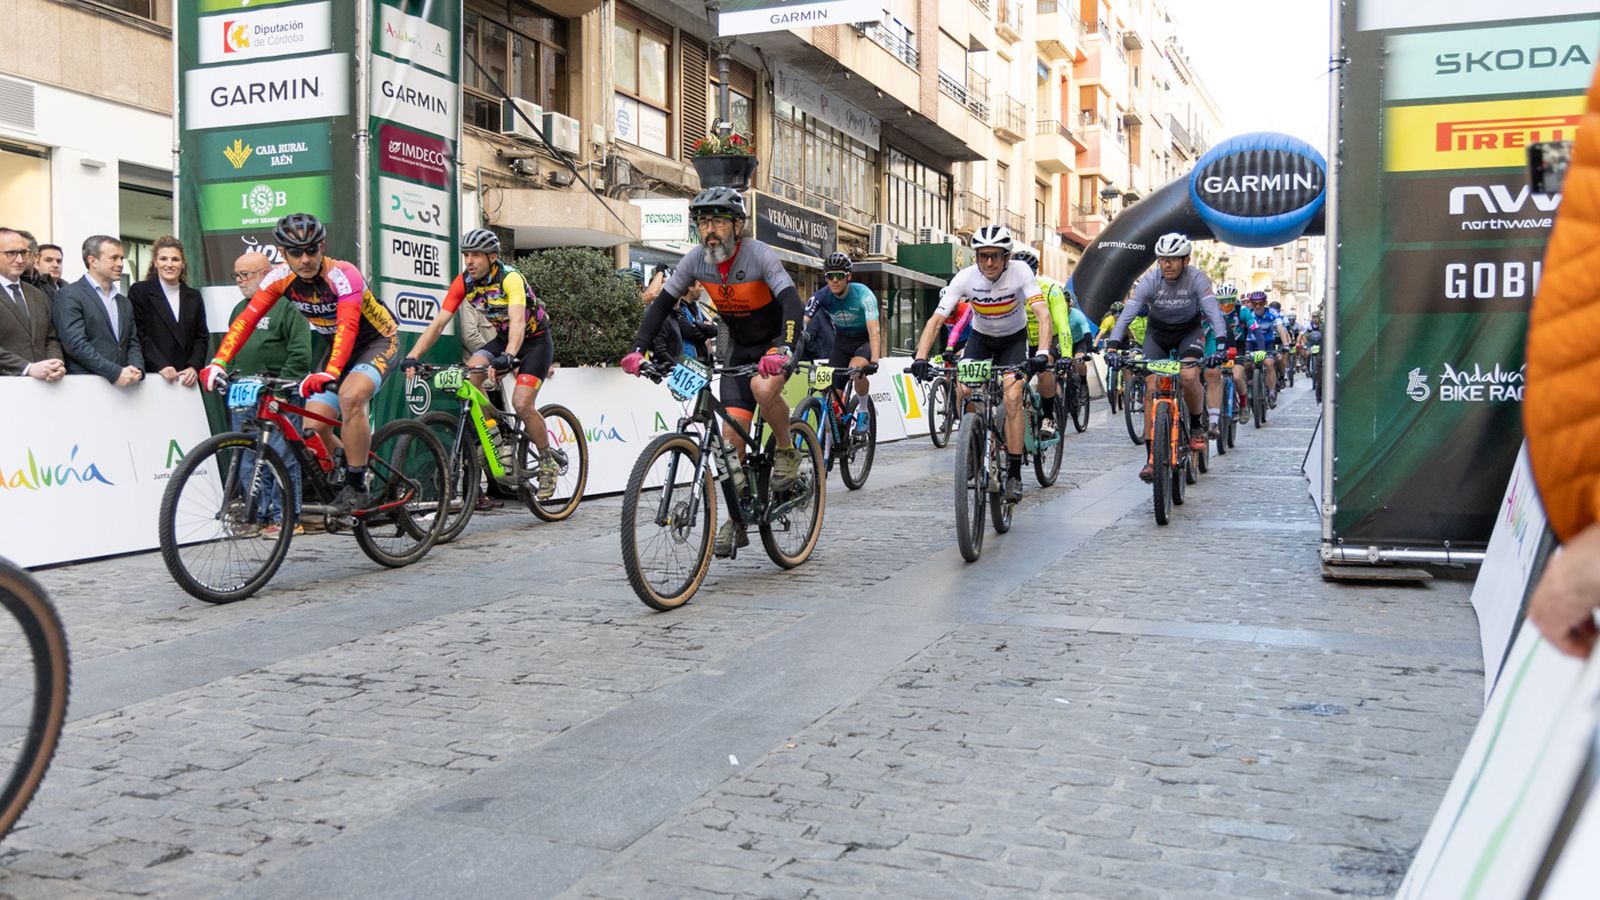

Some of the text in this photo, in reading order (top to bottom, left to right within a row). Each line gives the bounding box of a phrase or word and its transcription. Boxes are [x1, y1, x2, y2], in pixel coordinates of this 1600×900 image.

[769, 8, 828, 26] GARMIN
[254, 21, 304, 36] Diputación
[210, 76, 320, 108] GARMIN
[381, 80, 448, 116] GARMIN
[1436, 114, 1586, 152] PIRE
[255, 141, 308, 156] CAJA RURAL
[402, 142, 445, 166] IMDECO
[270, 154, 293, 167] JAÉN
[1203, 173, 1312, 194] GARMIN
[768, 208, 804, 234] VERÓNICA
[810, 222, 828, 241] JESÚS
[1461, 218, 1553, 231] northwave
[392, 239, 440, 262] POWER
[1097, 240, 1146, 250] garmin.com
[414, 260, 441, 277] ADE
[312, 302, 337, 314] RAC
[398, 298, 435, 321] CRUZ
[440, 370, 458, 385] 1057
[816, 371, 831, 382] 636
[961, 363, 988, 379] 1076
[1439, 362, 1526, 386] Andalucí
[1440, 385, 1485, 402] BIKE
[1489, 385, 1526, 402] RAC
